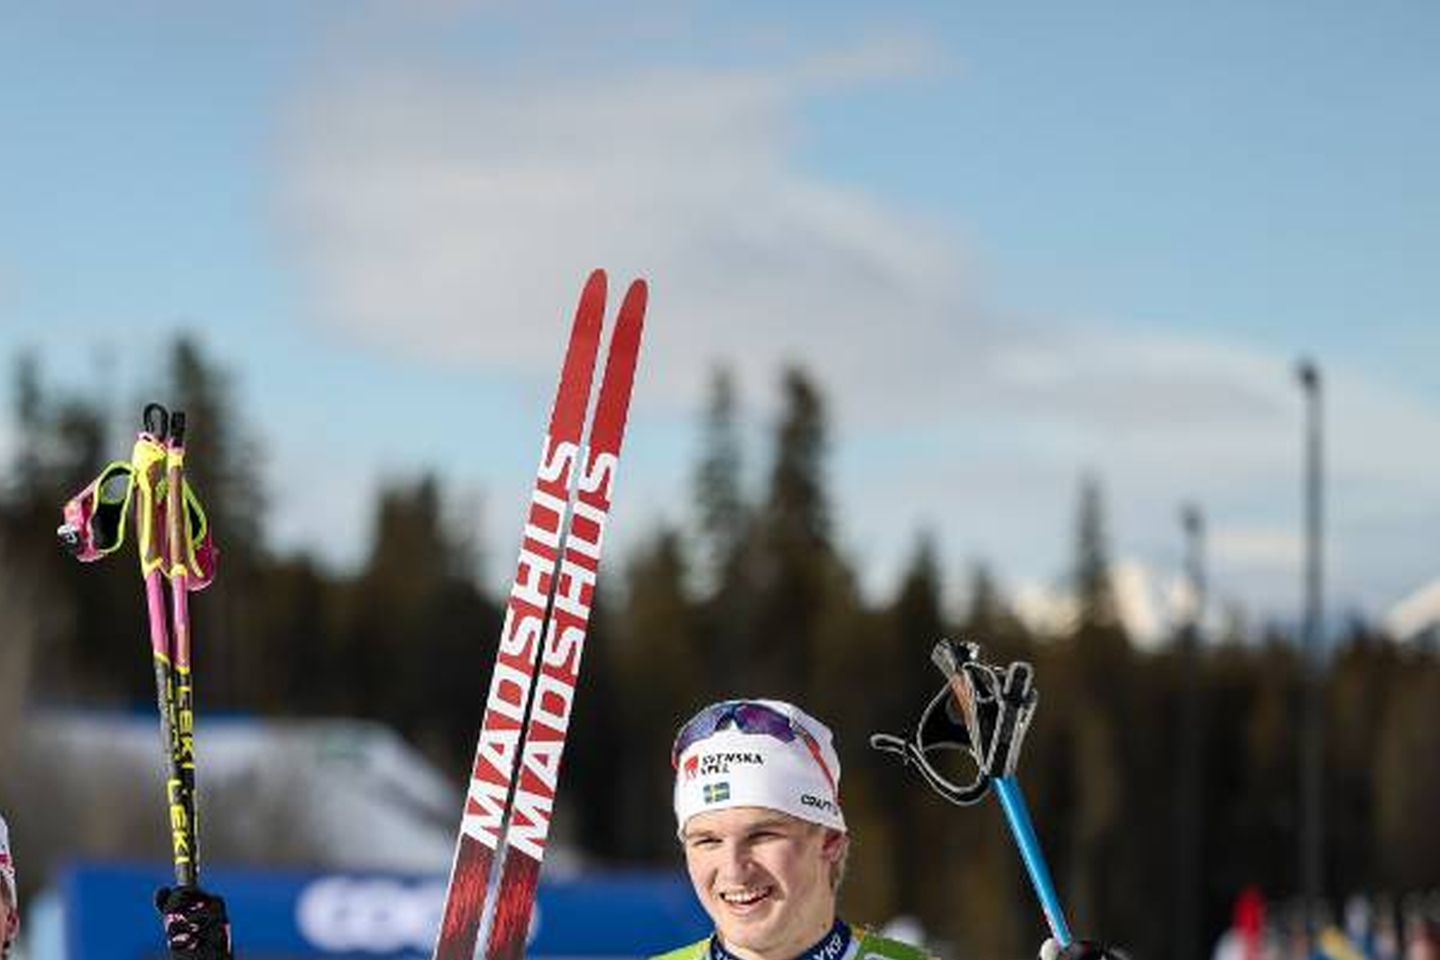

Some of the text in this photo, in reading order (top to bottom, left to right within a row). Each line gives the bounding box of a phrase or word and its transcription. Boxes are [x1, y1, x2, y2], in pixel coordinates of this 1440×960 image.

[176, 686, 195, 769] LEKI
[461, 434, 580, 850] MADSHUS
[507, 445, 619, 861] MADSHUS
[167, 779, 191, 864] LEKI
